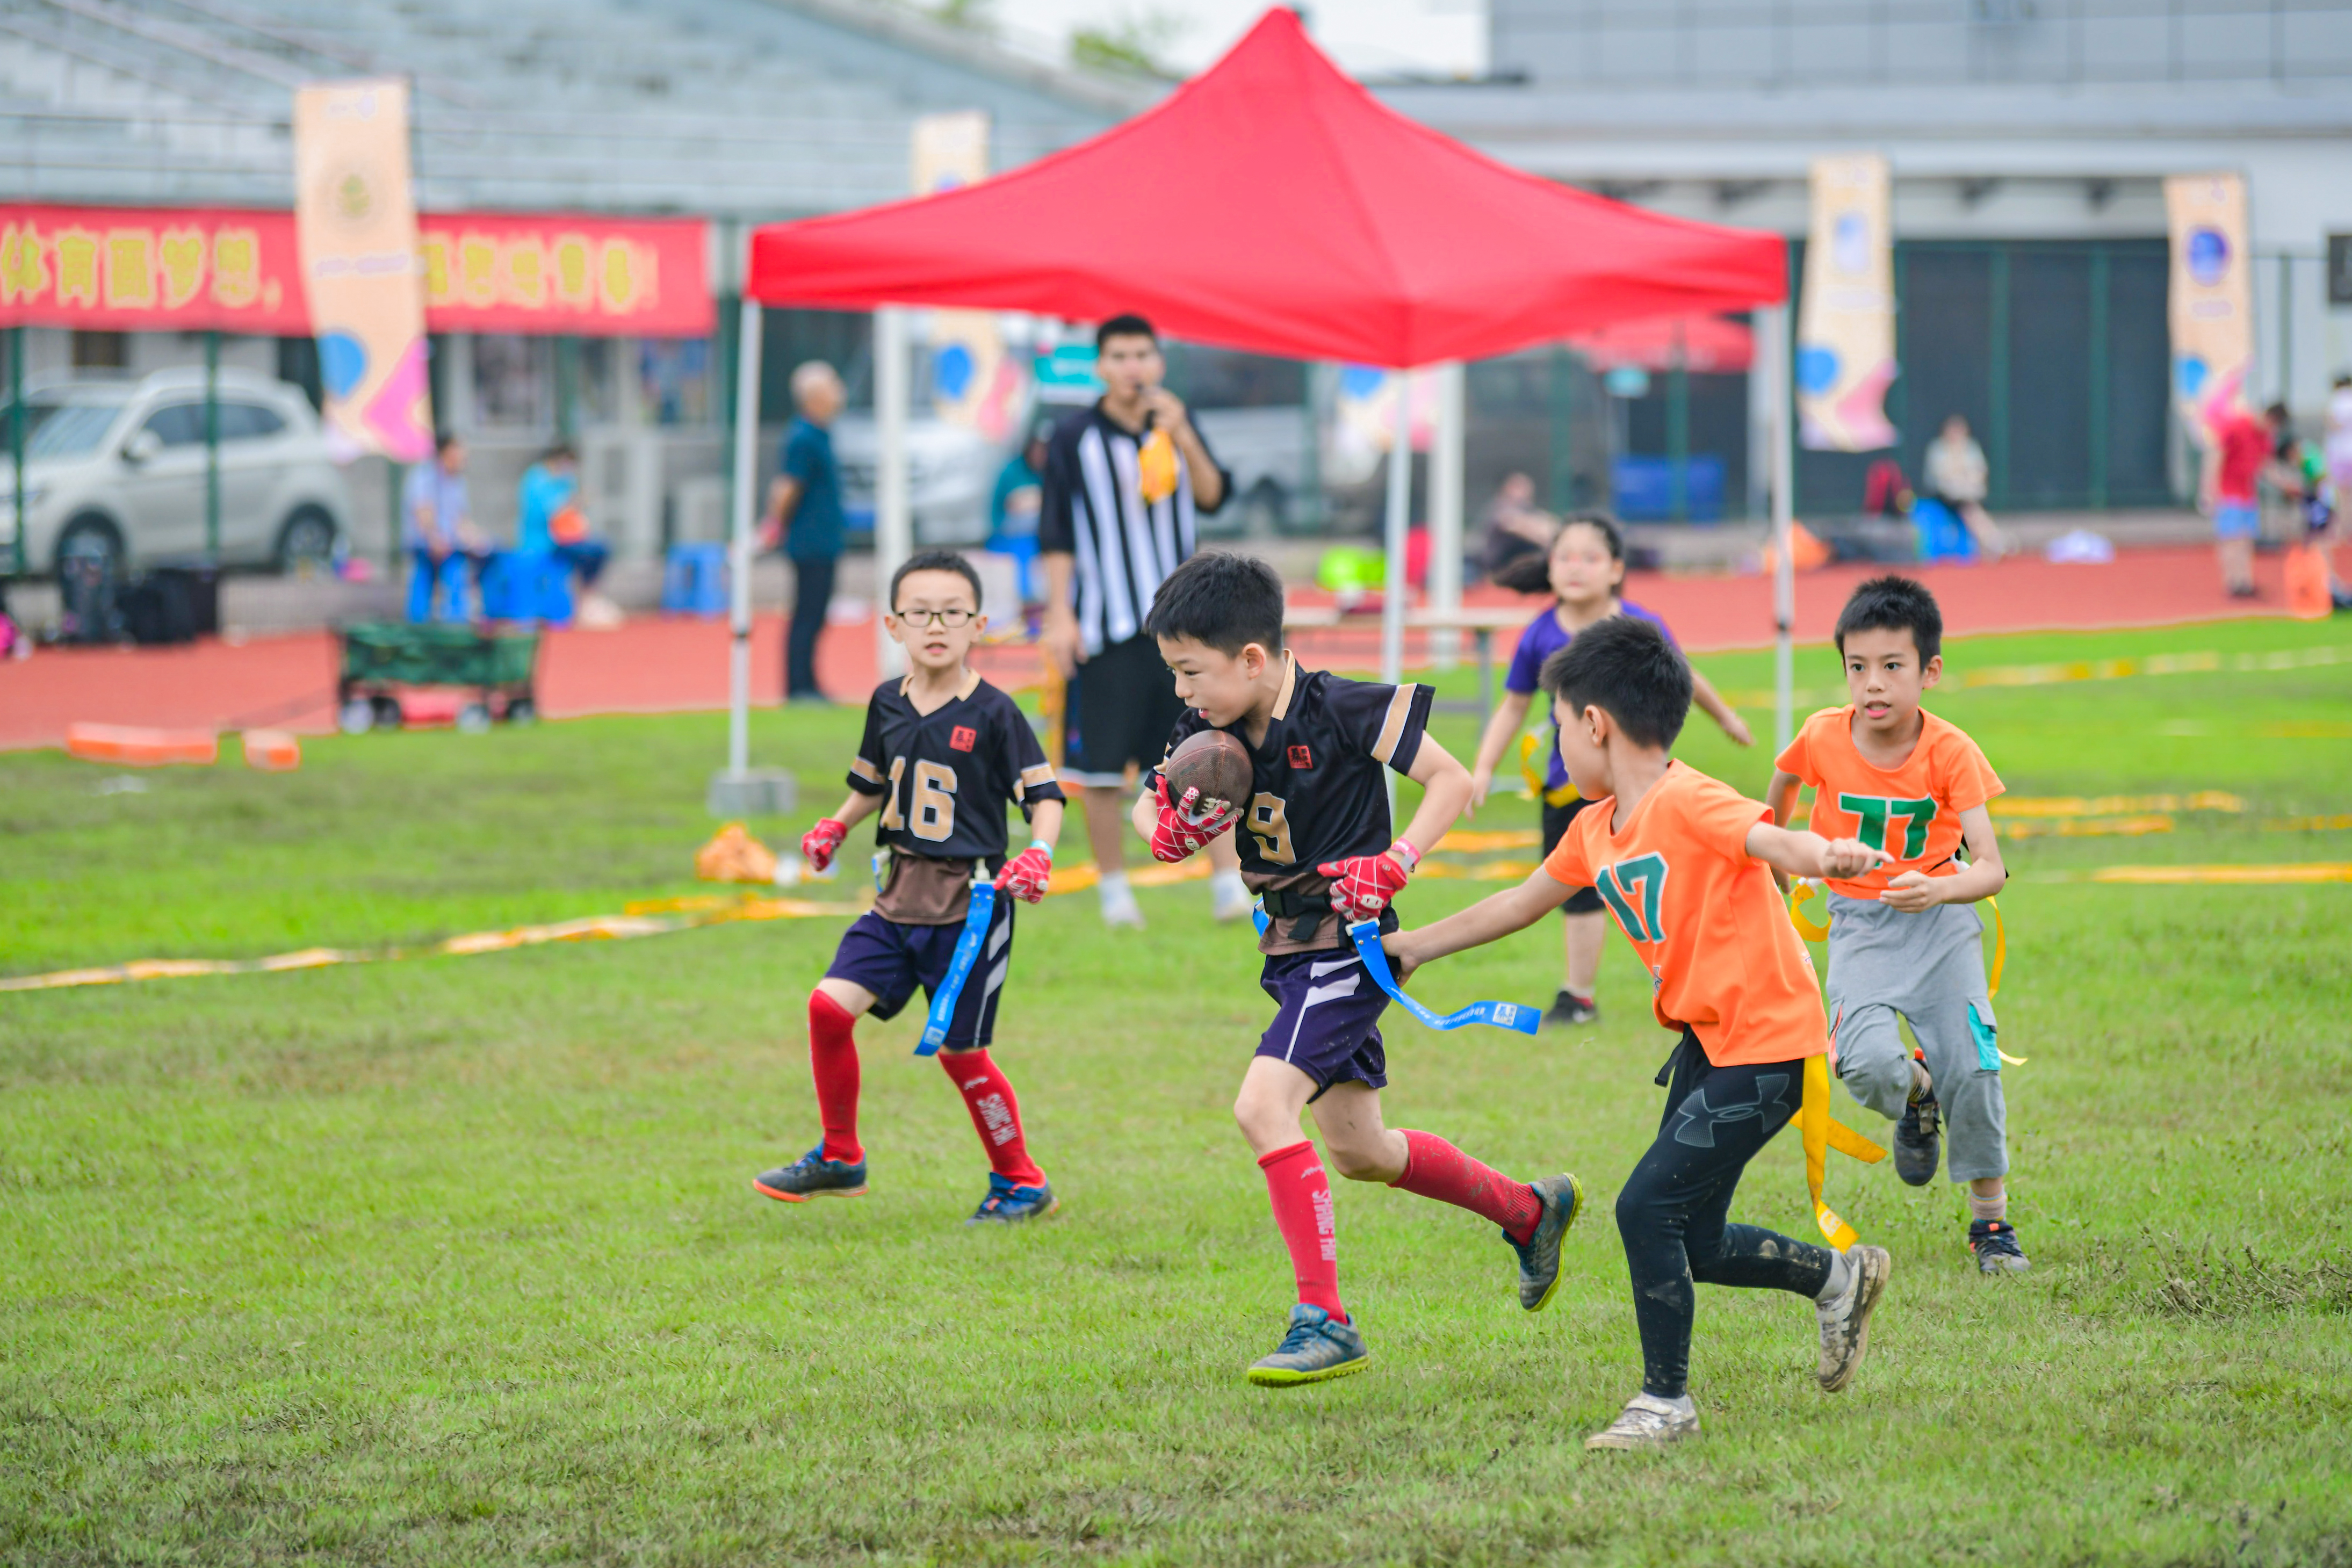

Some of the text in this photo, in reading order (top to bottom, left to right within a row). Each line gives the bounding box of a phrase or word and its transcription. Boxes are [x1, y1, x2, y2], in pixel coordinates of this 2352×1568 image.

[879, 755, 958, 843] 16
[1246, 791, 1297, 866] 9
[1838, 792, 1939, 869] 77
[1594, 851, 1669, 944] 17
